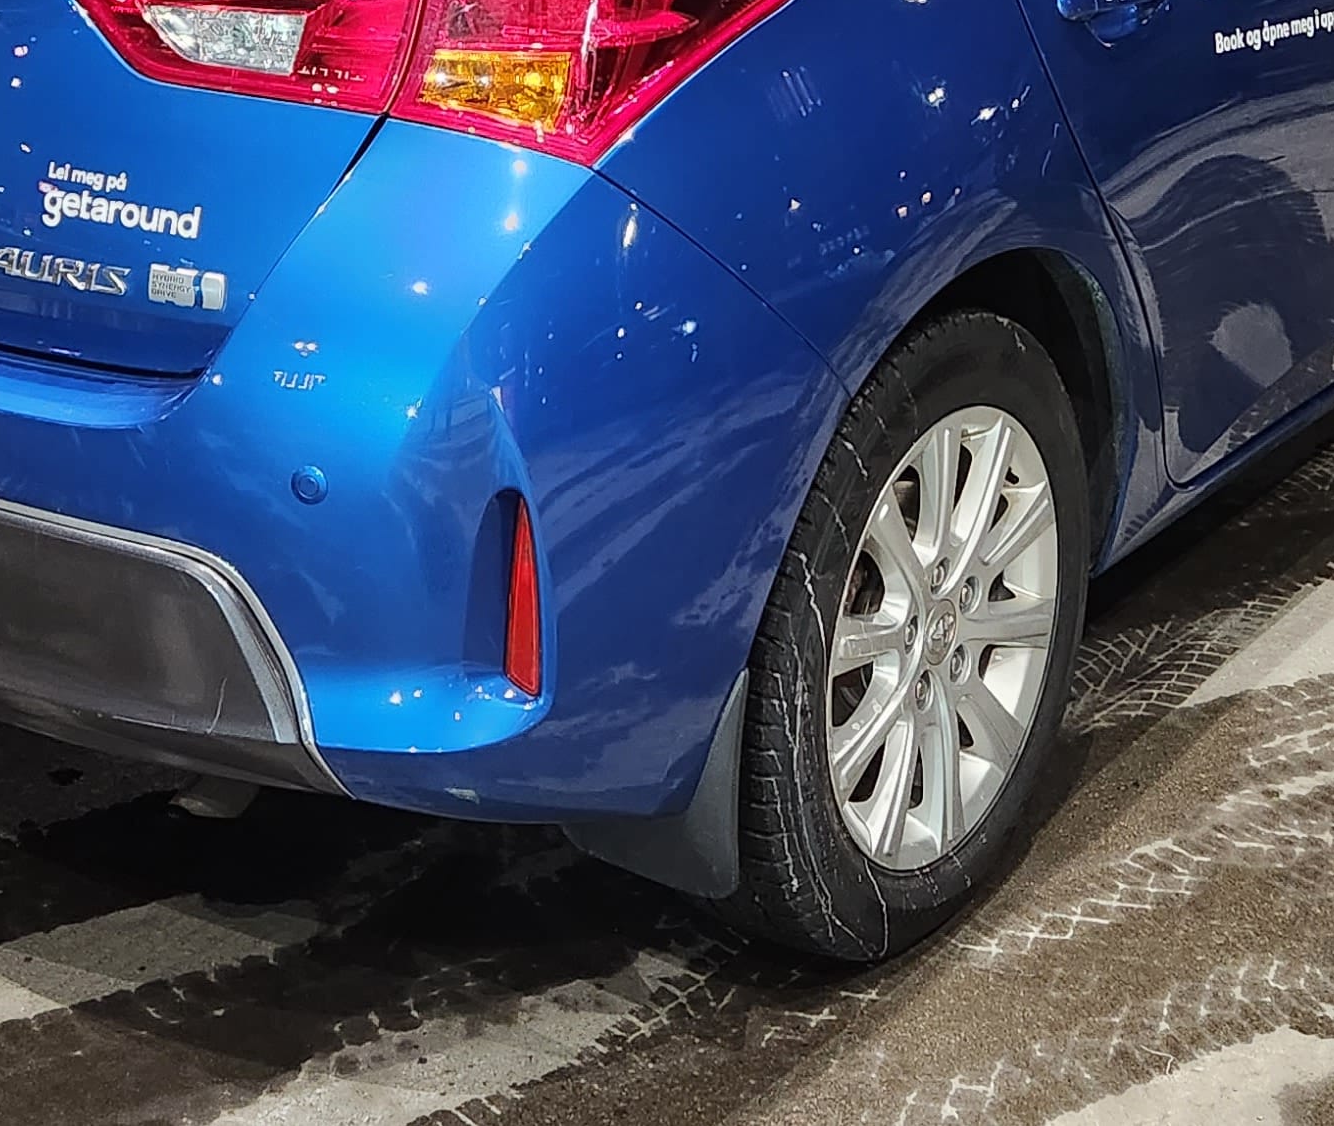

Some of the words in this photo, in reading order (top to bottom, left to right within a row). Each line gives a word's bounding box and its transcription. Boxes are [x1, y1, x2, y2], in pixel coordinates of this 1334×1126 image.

[1215, 28, 1245, 55] Book
[1246, 30, 1262, 51] og
[1262, 21, 1290, 47] åpne
[1290, 18, 1315, 38] meg
[1314, 9, 1320, 30] i
[47, 160, 71, 180] Lei
[71, 168, 105, 189] meg
[106, 172, 128, 193] på
[42, 189, 203, 240] getaround
